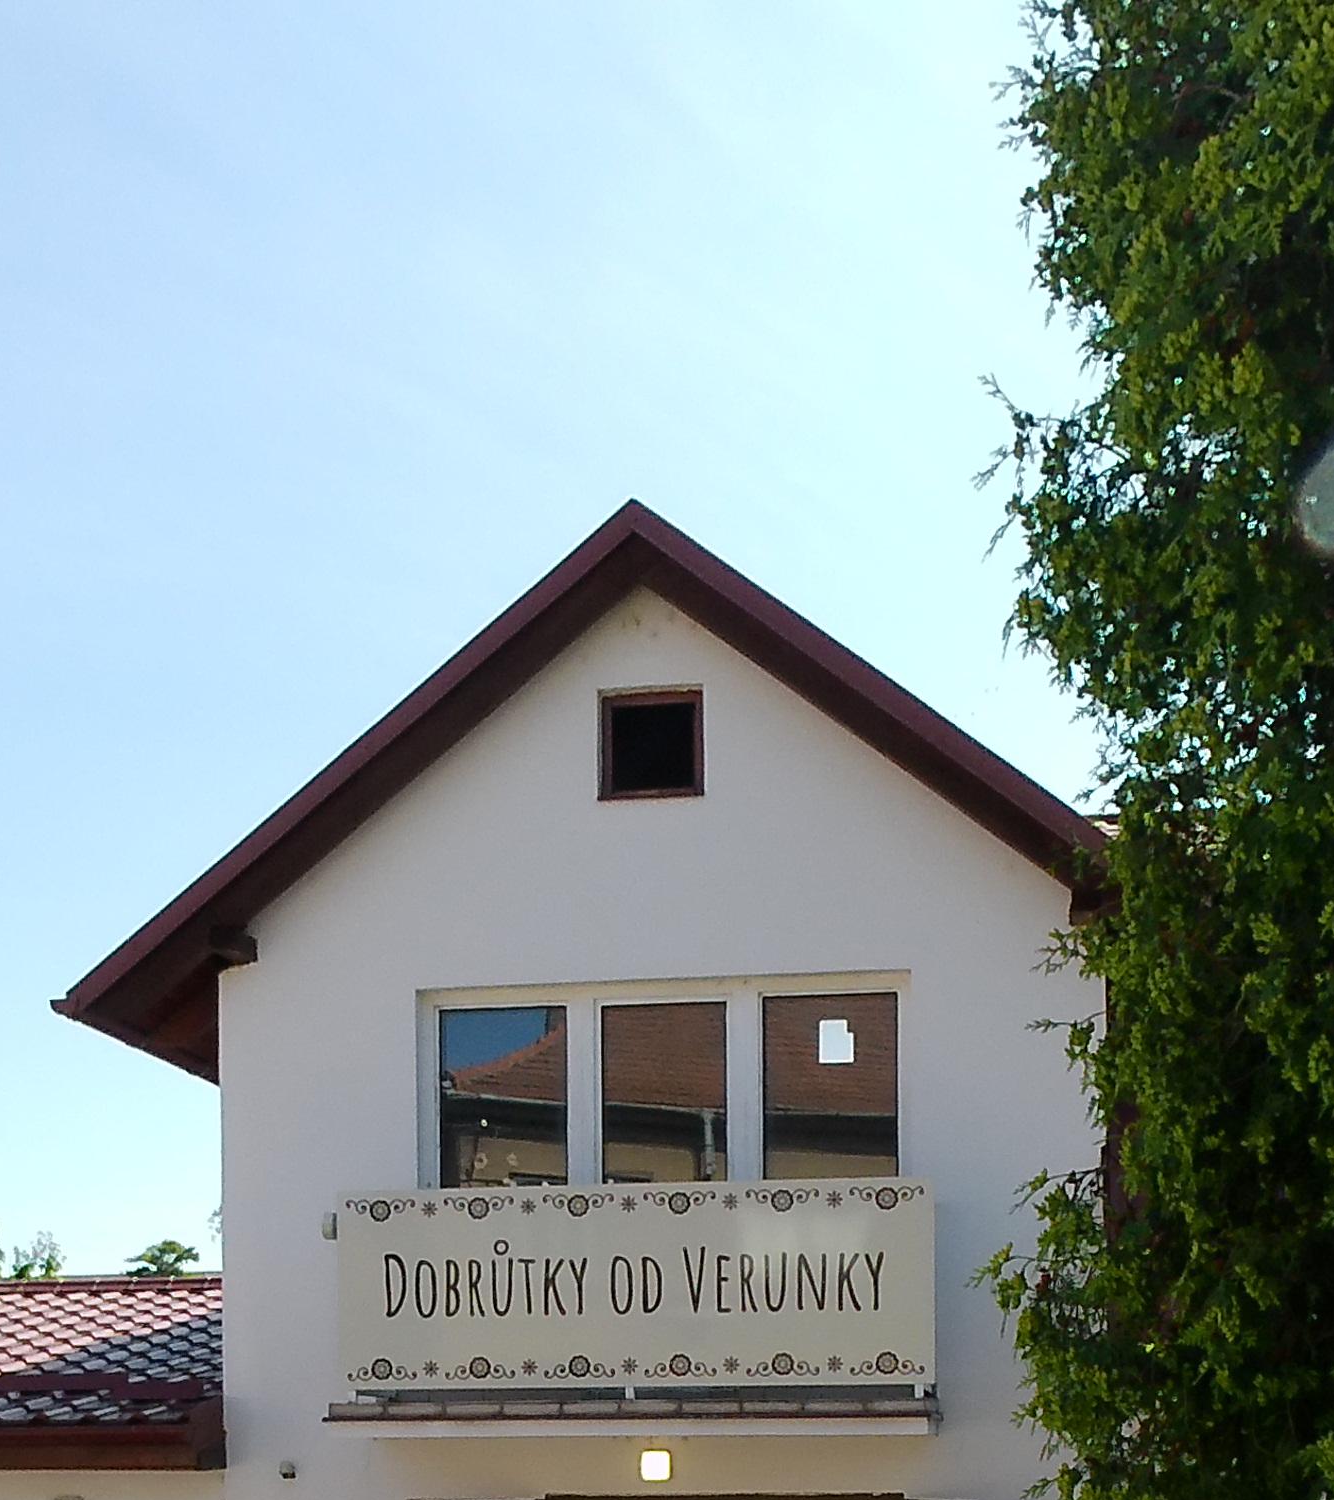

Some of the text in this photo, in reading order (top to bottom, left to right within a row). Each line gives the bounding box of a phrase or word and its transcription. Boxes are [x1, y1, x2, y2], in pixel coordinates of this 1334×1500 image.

[383, 1239, 886, 1320] DOBRŮTKY OD VERUNKY
